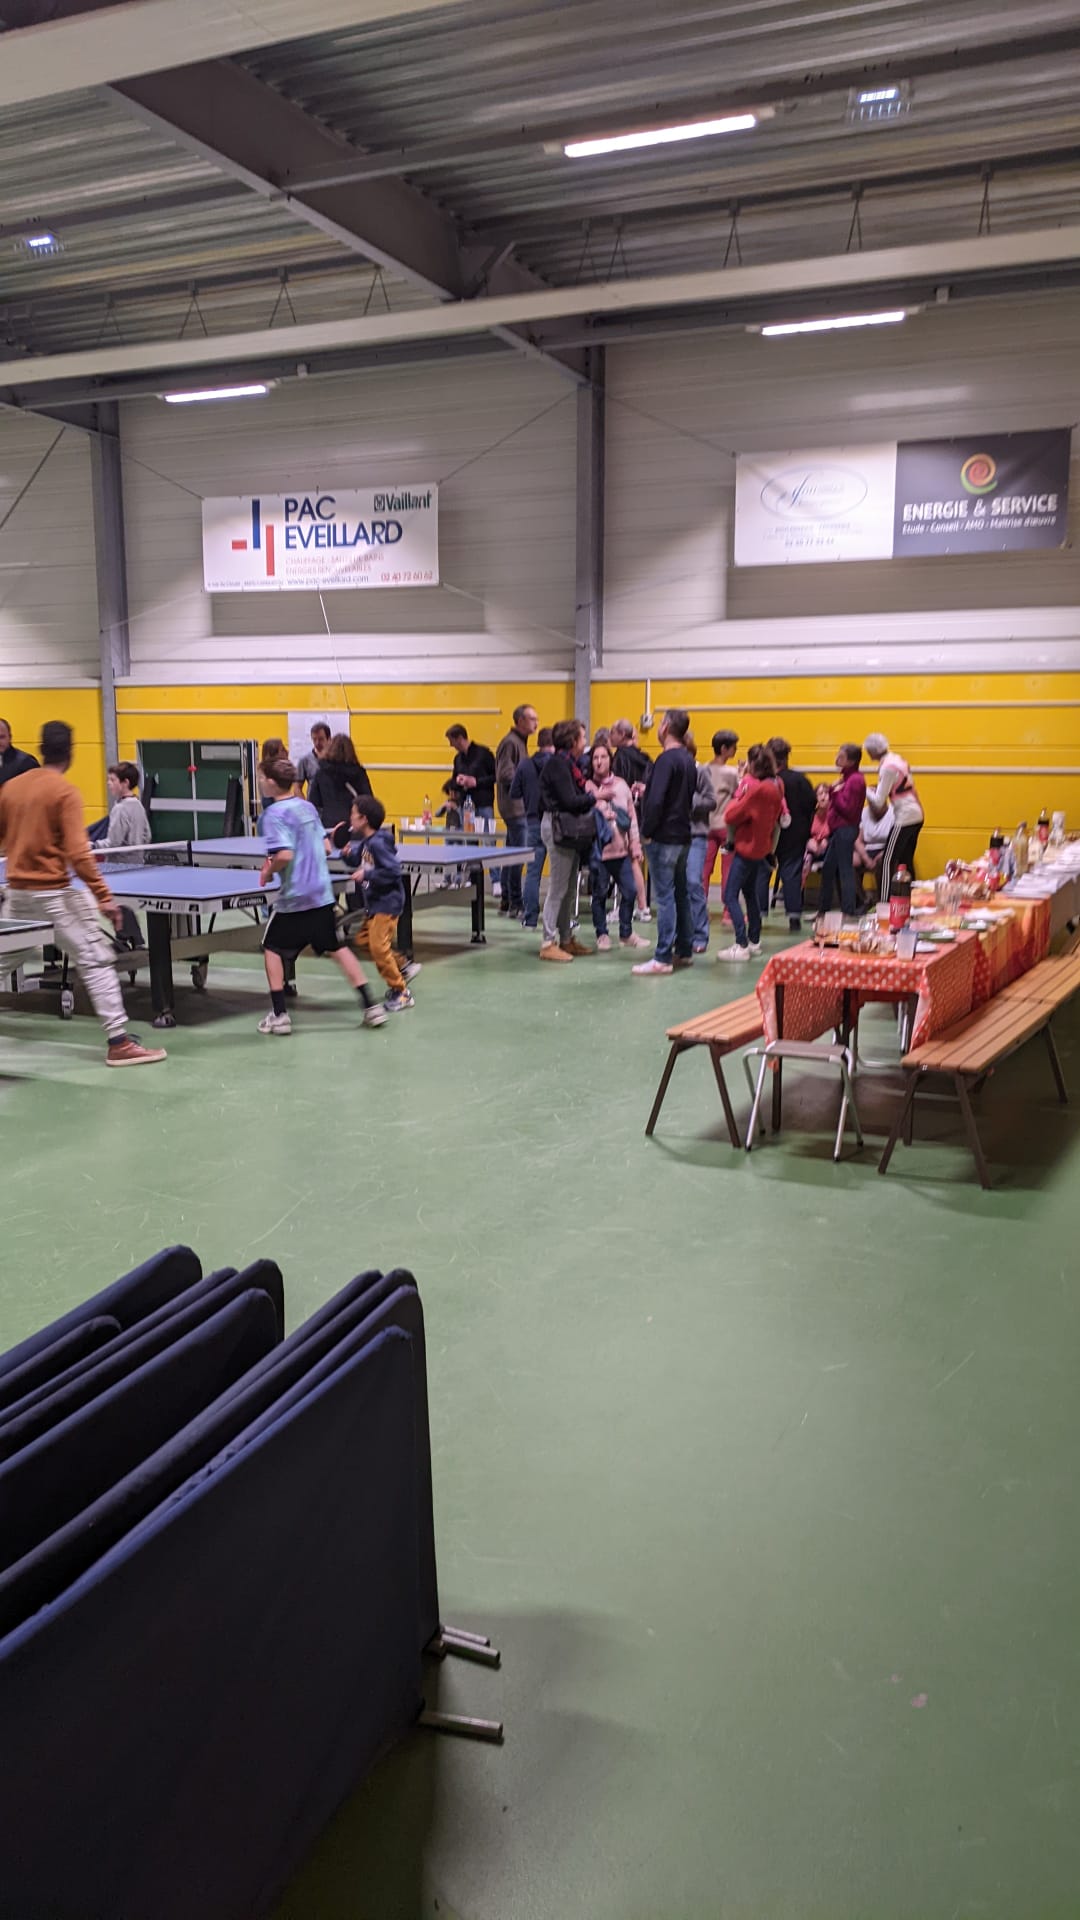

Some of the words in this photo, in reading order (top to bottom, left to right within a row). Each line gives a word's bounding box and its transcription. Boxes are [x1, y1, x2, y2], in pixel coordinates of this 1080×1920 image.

[284, 496, 336, 522] PAC
[386, 489, 432, 511] Vaillant
[902, 499, 969, 522] ENERGIE
[973, 498, 987, 517] &
[991, 493, 1058, 516] SERVICE
[284, 520, 403, 549] EVEILLARD
[930, 521, 959, 533] Conseil
[964, 519, 985, 531] AMO
[380, 572, 390, 582] 02
[392, 571, 401, 582] 40
[413, 571, 422, 580] 60
[138, 899, 172, 911] 740
